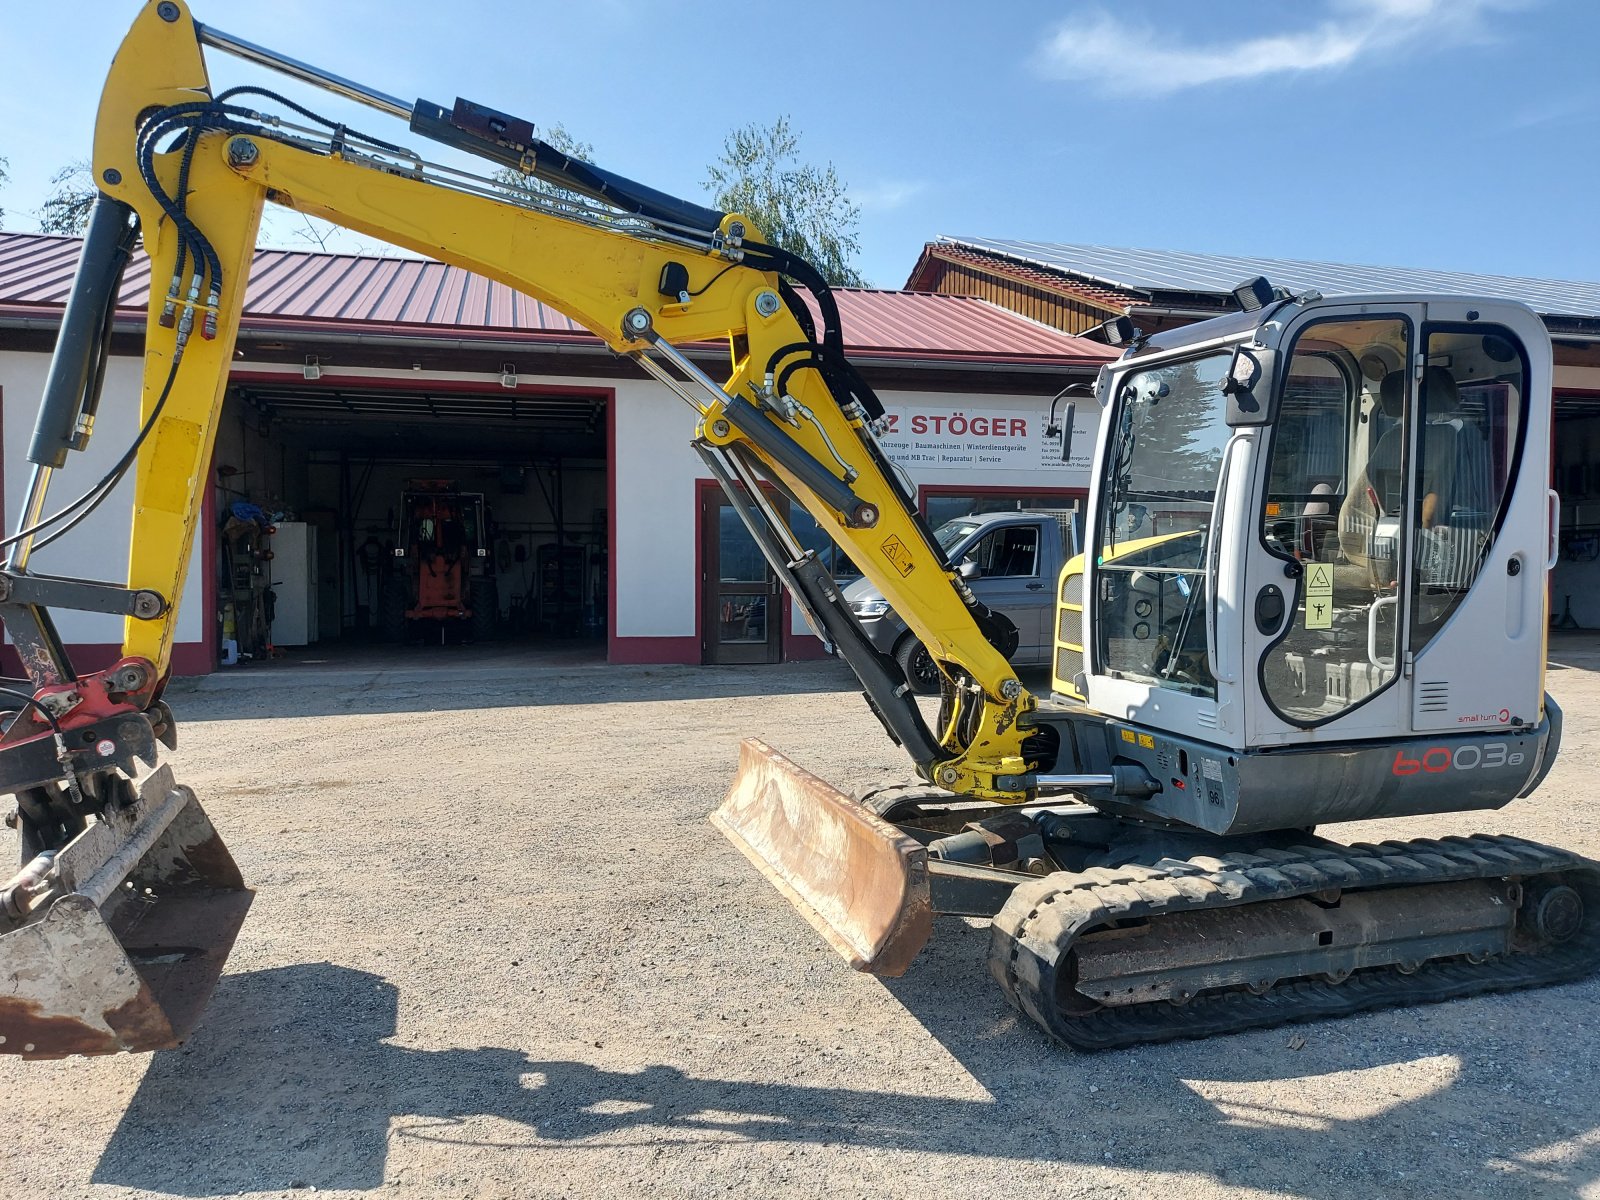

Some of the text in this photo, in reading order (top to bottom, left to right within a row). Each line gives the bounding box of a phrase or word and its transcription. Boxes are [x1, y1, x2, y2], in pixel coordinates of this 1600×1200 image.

[911, 412, 1027, 437] STÖGER
[880, 441, 1027, 452] ahrzeuge Baumaschinen Winterdienstgeräte
[942, 455, 973, 463] Reparatur
[979, 455, 1002, 463] Service
[1457, 714, 1479, 723] small
[1209, 790, 1220, 805] 96
